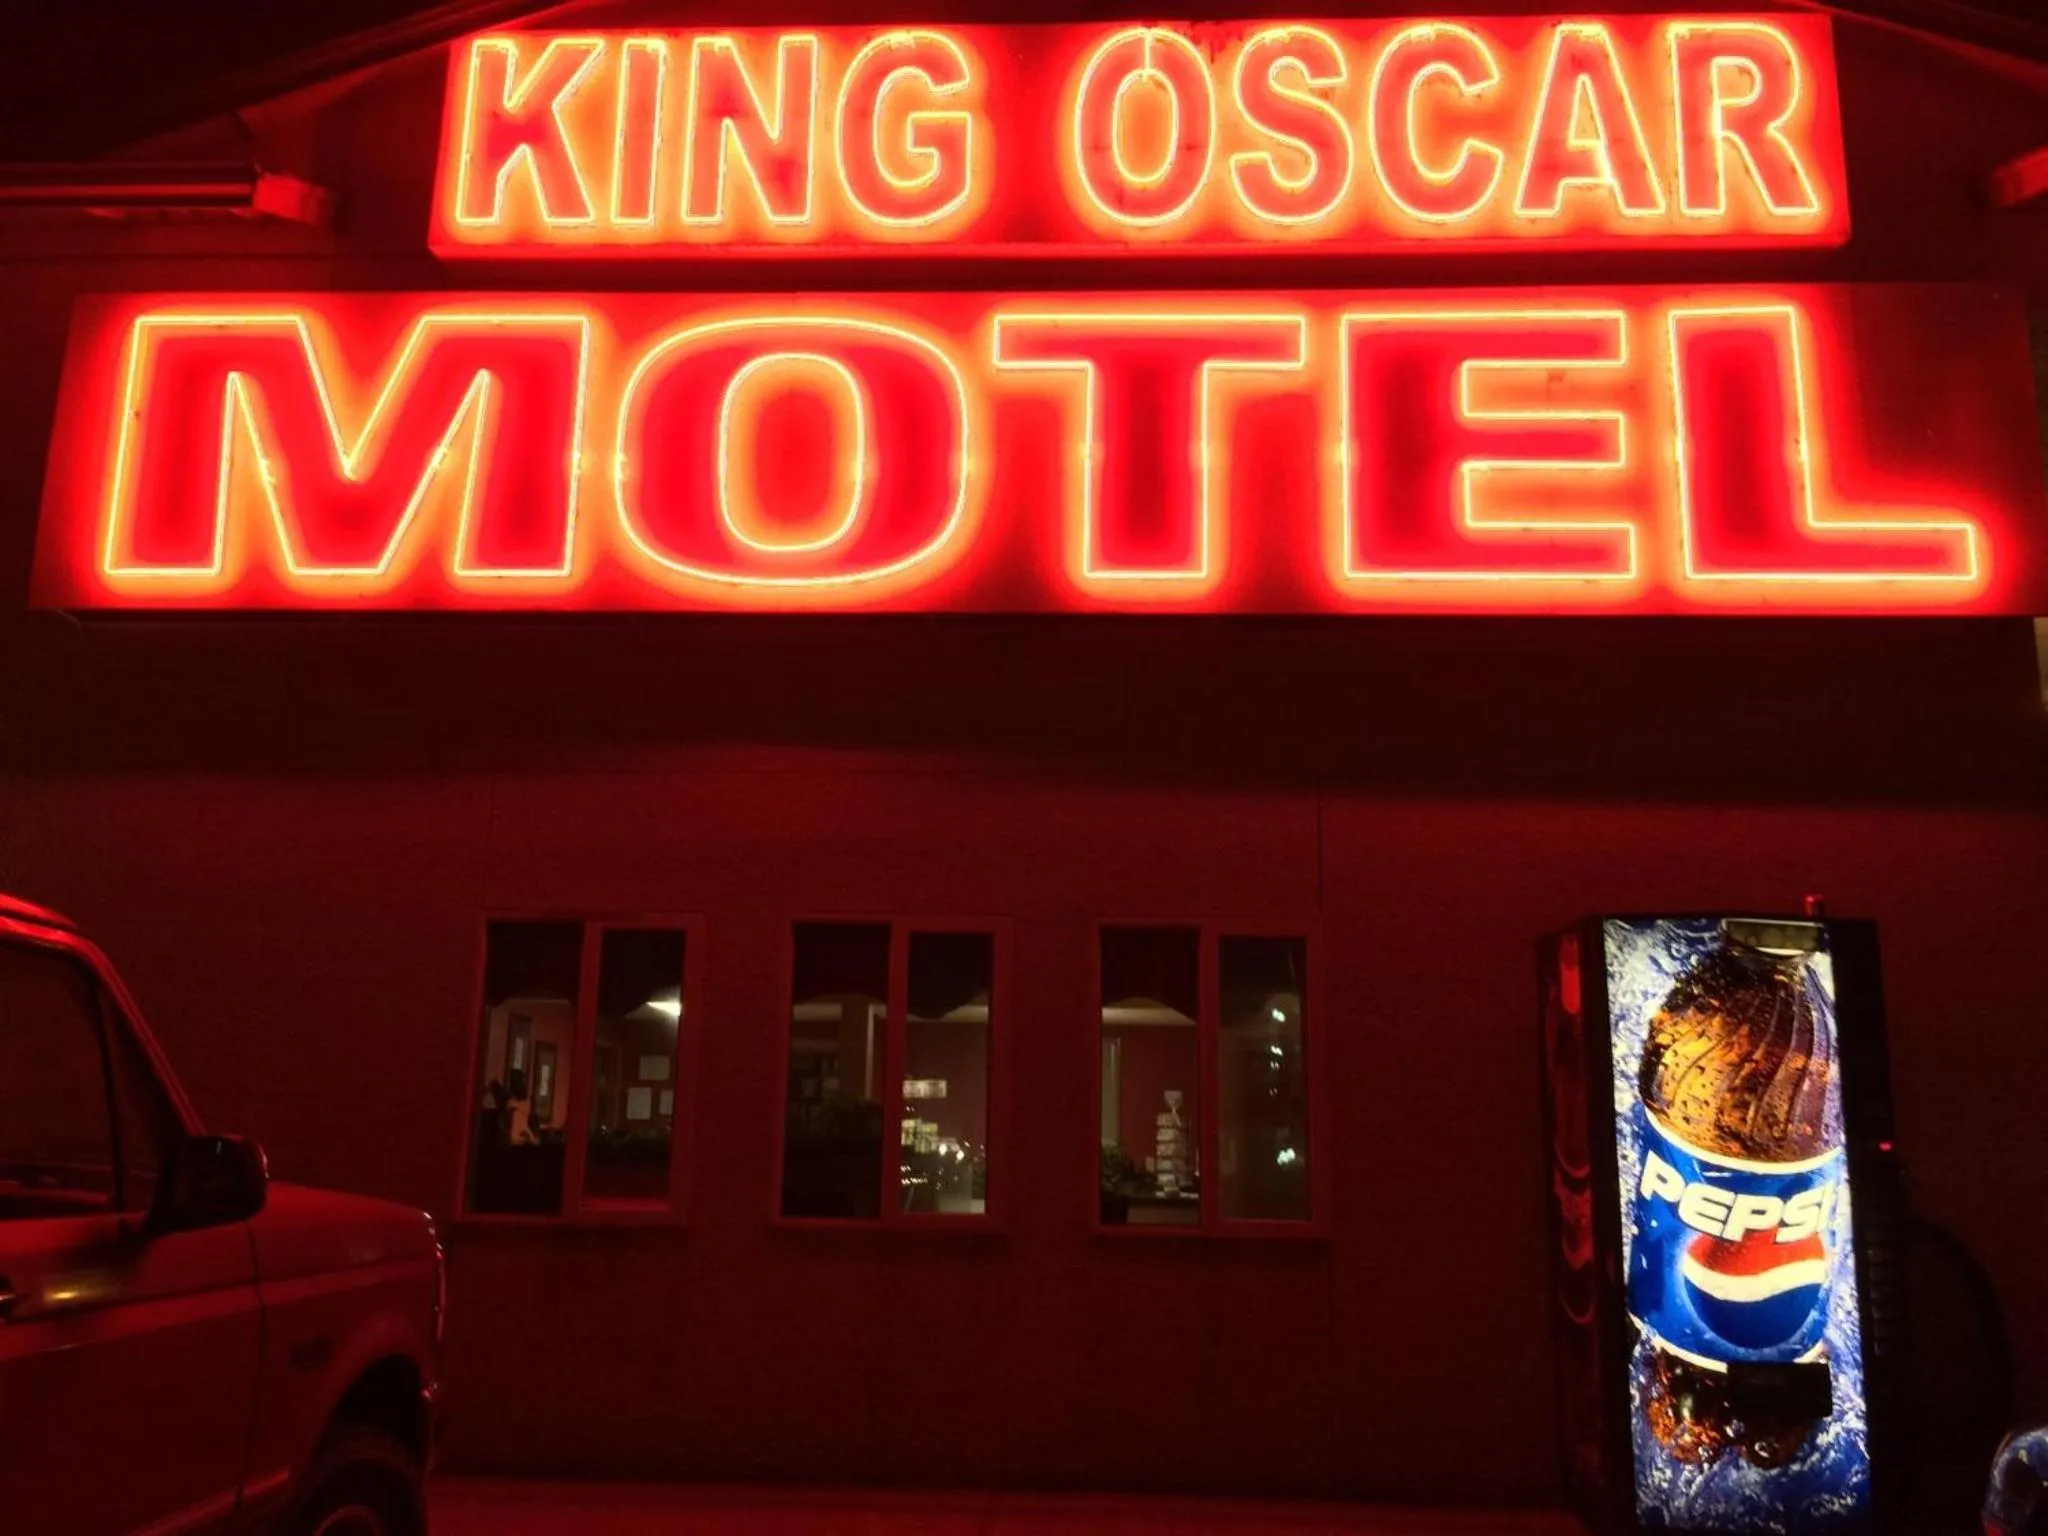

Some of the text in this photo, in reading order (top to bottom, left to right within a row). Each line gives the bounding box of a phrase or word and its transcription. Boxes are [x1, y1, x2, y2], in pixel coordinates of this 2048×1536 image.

[455, 23, 1819, 226] KING OSCAR
[104, 305, 1978, 586] MOTEL
[1640, 1149, 1834, 1244] PEPSI
